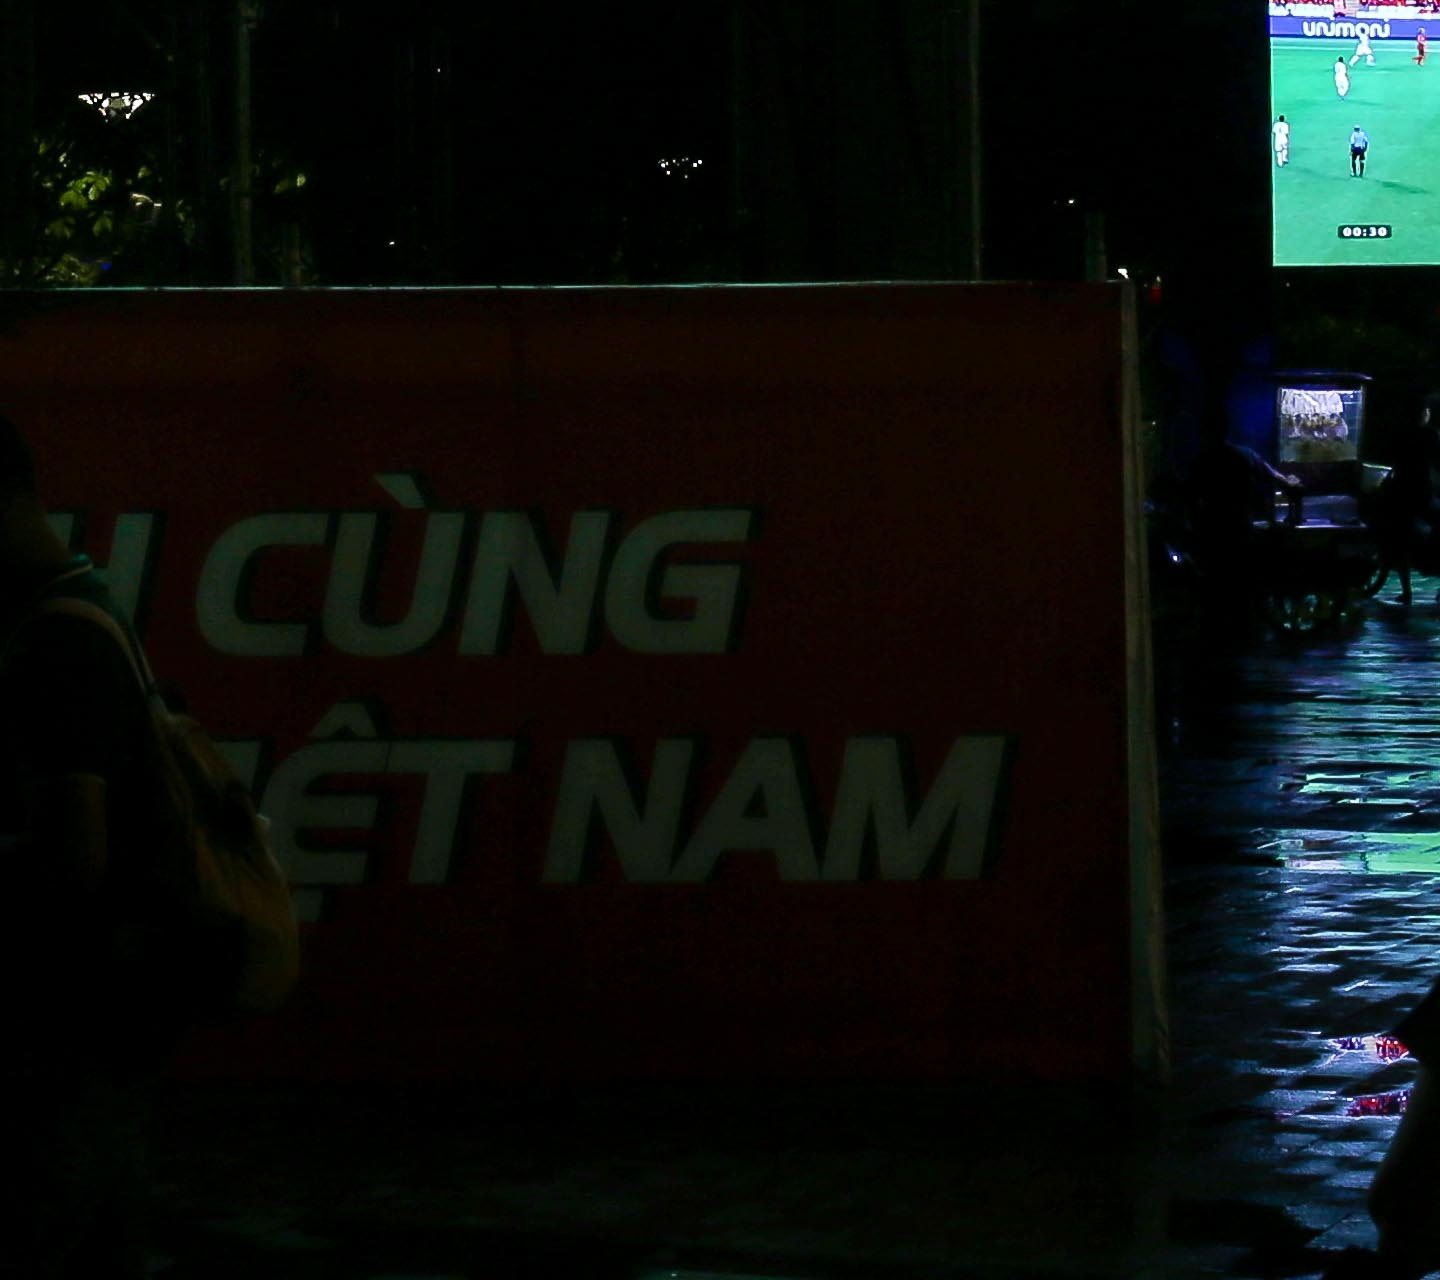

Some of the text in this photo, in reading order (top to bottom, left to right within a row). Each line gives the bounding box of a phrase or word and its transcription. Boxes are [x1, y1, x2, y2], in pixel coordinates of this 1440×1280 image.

[1341, 226, 1388, 238] 00:30
[194, 472, 754, 657] CÙNG
[541, 734, 1008, 883] NAM
